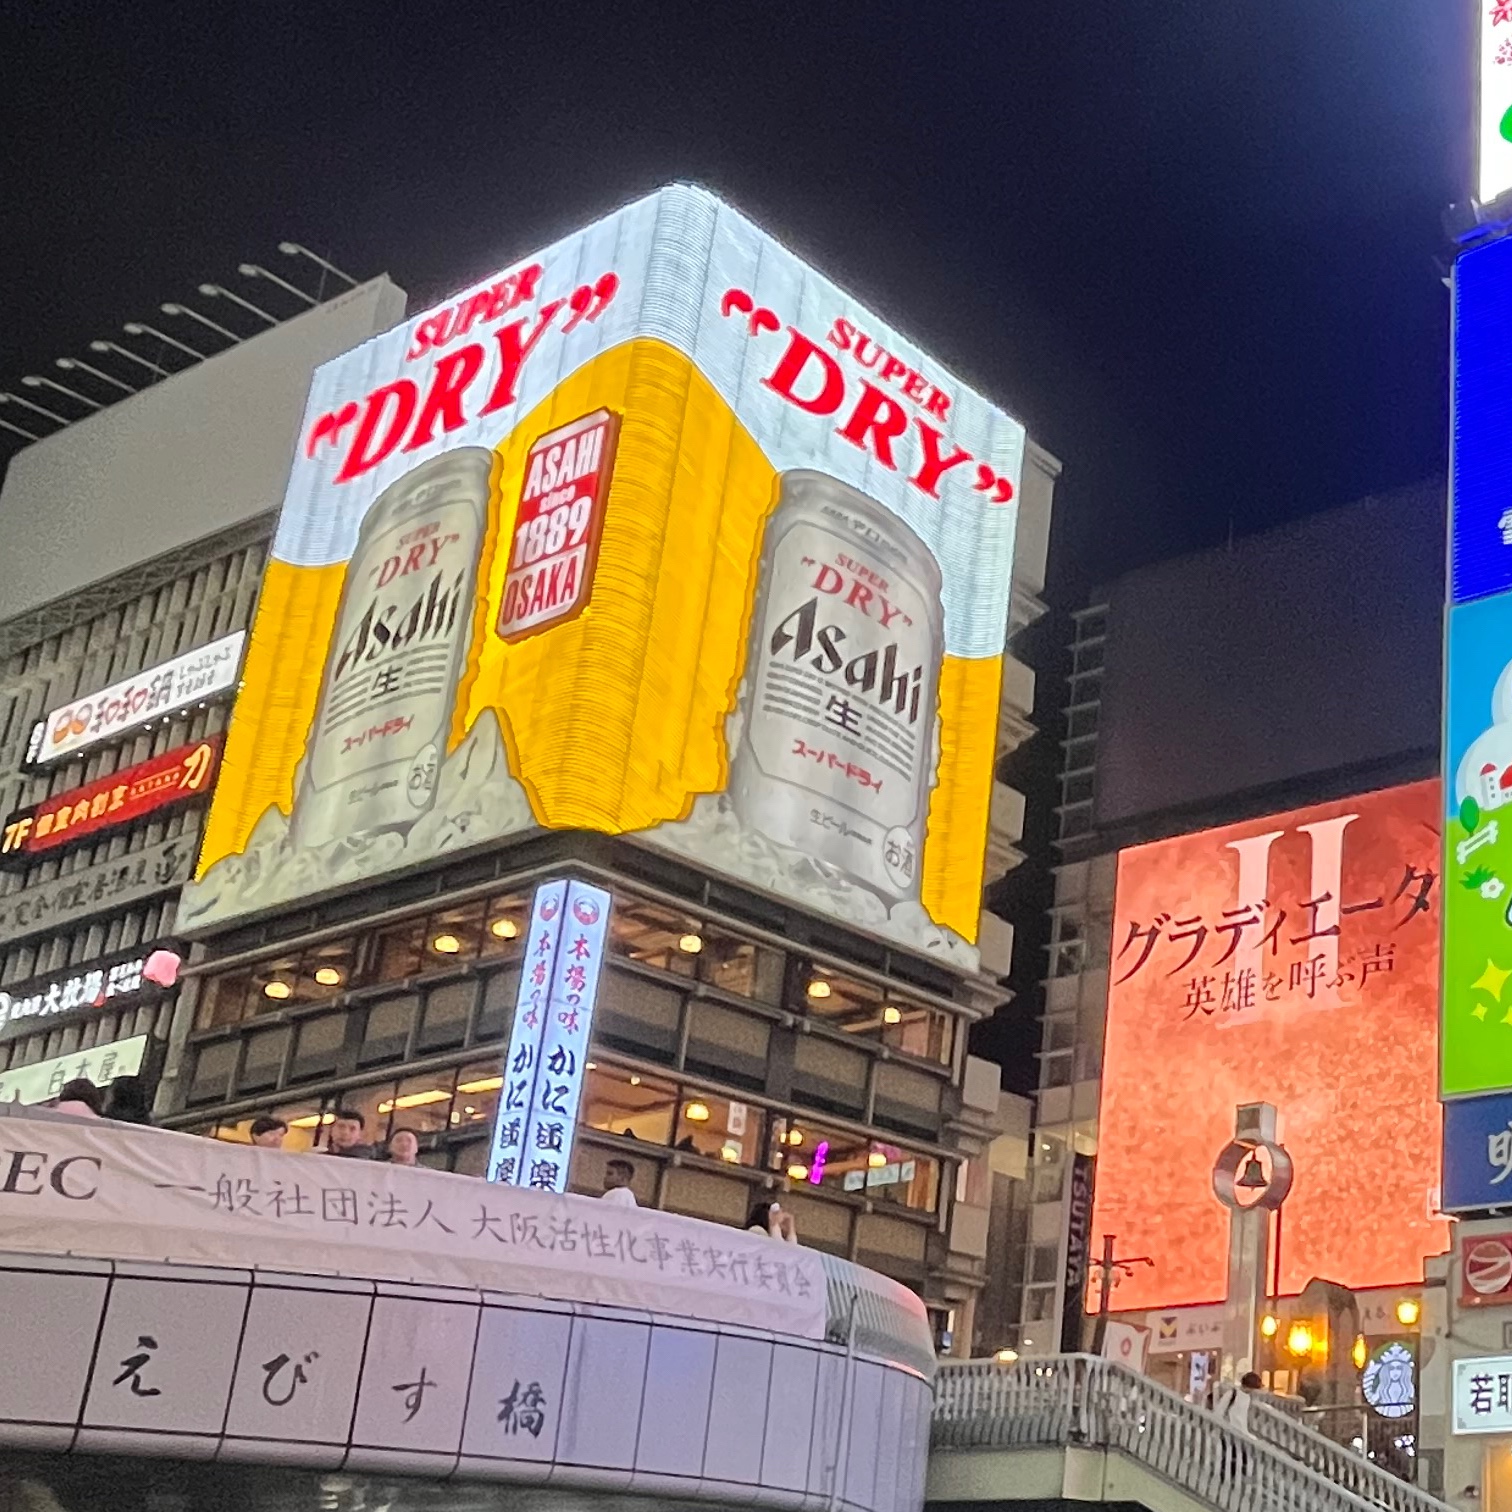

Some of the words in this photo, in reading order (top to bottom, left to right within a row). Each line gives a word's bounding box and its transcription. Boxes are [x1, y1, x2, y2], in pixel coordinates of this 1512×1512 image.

[405, 262, 544, 363] SUPER
[827, 315, 954, 424] SUPER
[522, 424, 606, 503] ASAHI
[538, 484, 577, 514] since
[512, 494, 593, 570] 1889
[834, 552, 890, 595] SUPER
[334, 566, 466, 682] Asahi
[501, 554, 579, 626] OSAKA
[370, 664, 404, 701] 生
[770, 596, 924, 725] Asahi
[824, 694, 863, 738] 生
[791, 738, 884, 794] スーパードライ
[1113, 863, 1439, 987] グラディエータ
[557, 932, 593, 1036] 本場の味
[1181, 941, 1398, 1022] 英雄を呼ぶ声
[153, 1172, 458, 1237] 一般社団法人
[471, 1204, 811, 1299] 大阪活性化事業実行委員会
[1065, 1162, 1088, 1287] TSUTAYA
[112, 1335, 548, 1439] えびす橋
